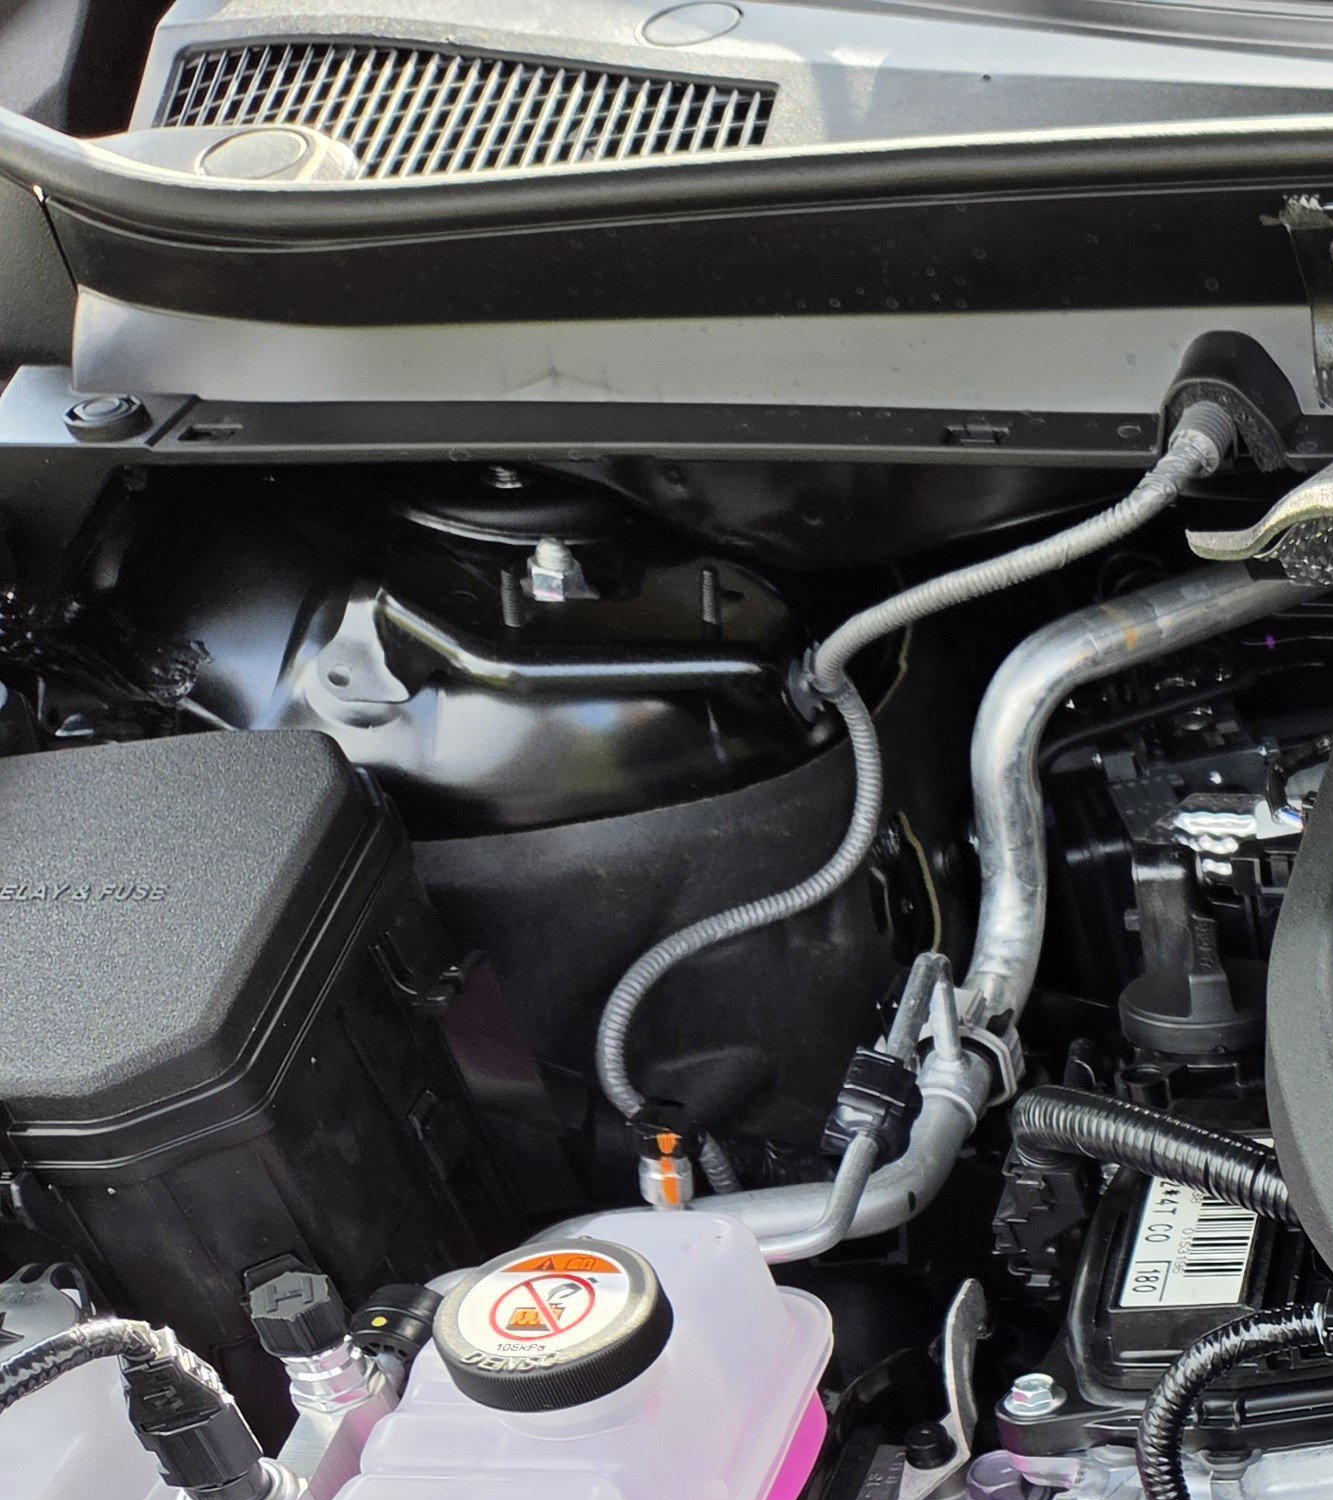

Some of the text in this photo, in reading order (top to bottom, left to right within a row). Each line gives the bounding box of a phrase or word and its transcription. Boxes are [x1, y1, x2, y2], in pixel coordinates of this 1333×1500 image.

[0, 883, 169, 901] ELAY & FUSE
[1145, 1224, 1173, 1243] CO
[1132, 1269, 1160, 1293] 180
[460, 1351, 560, 1375] DENSO
